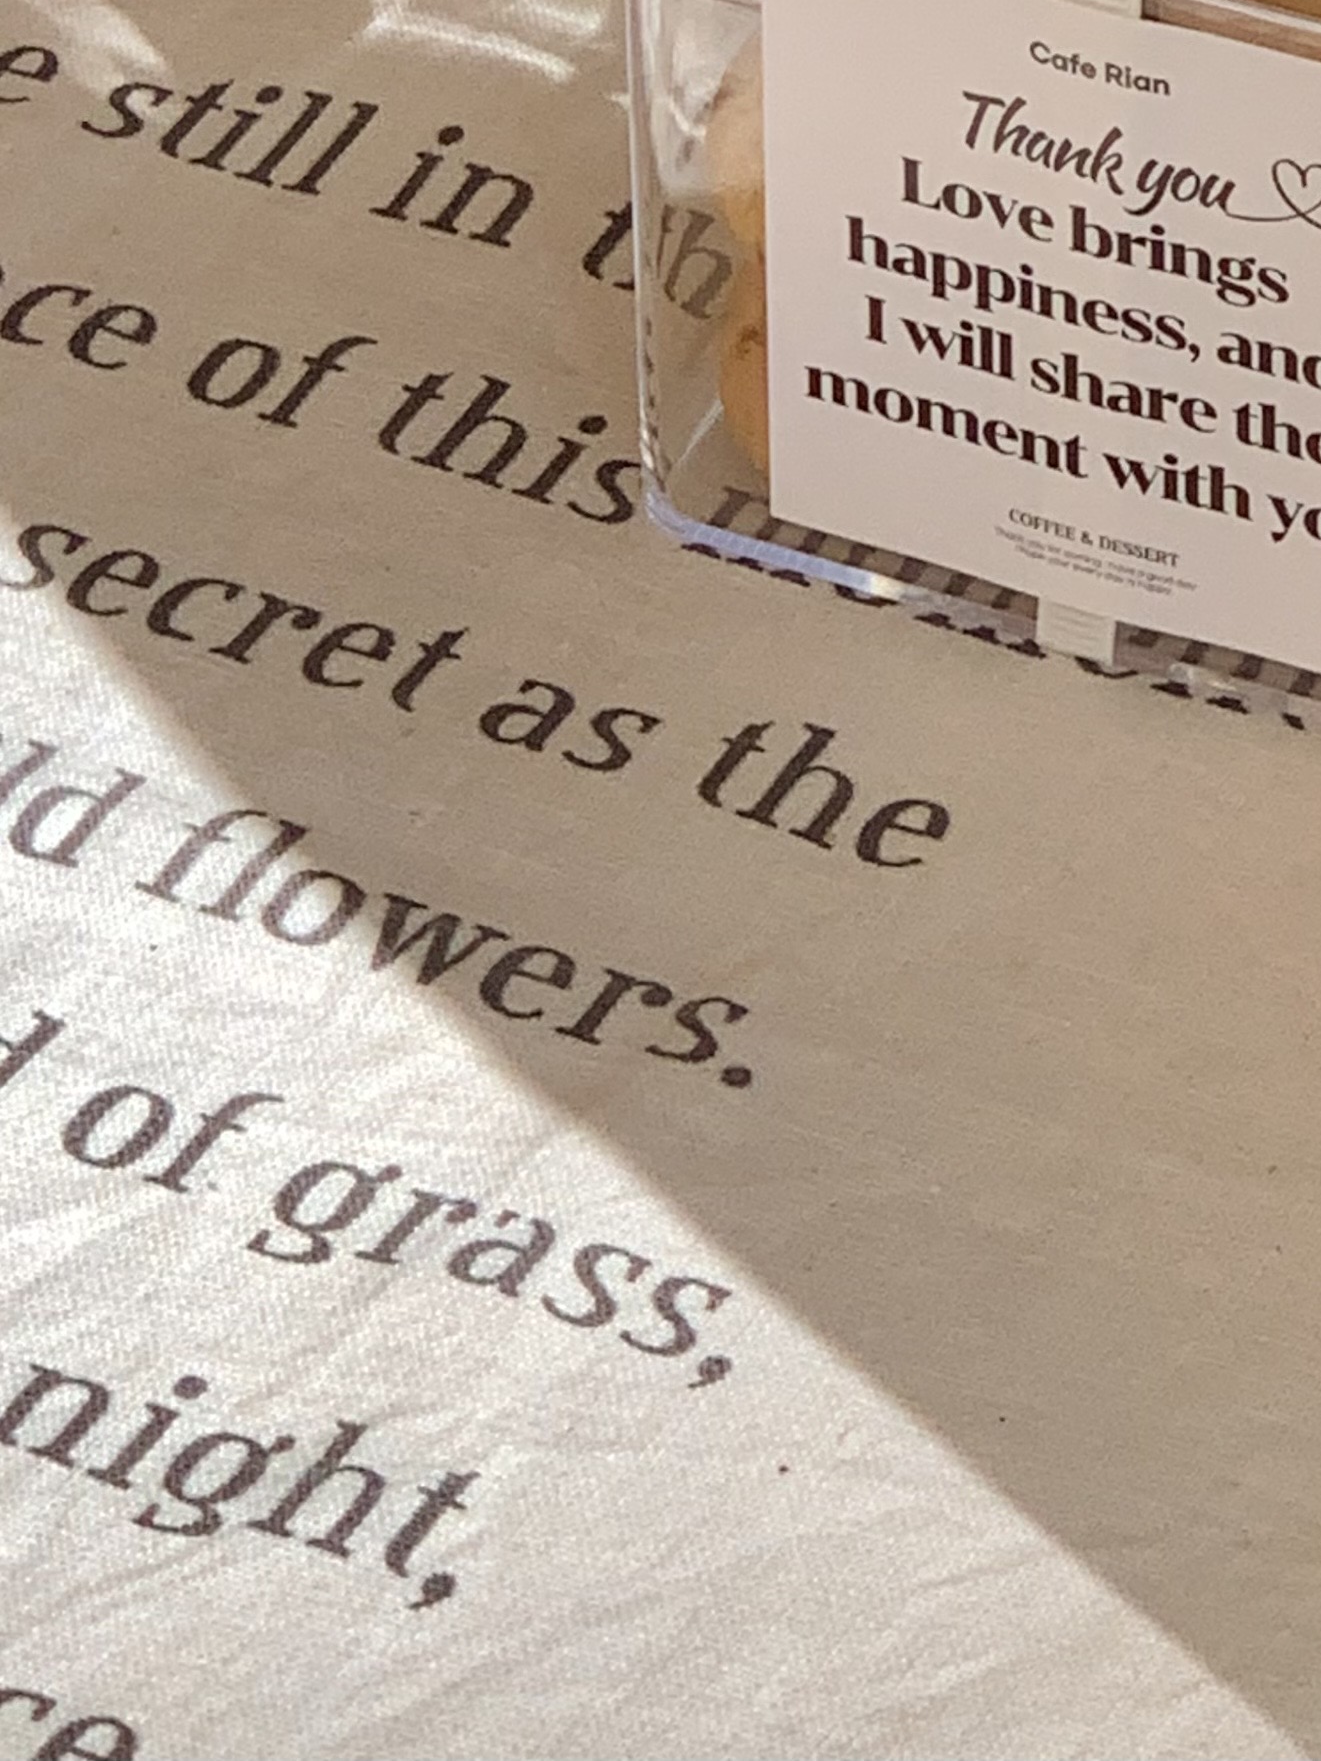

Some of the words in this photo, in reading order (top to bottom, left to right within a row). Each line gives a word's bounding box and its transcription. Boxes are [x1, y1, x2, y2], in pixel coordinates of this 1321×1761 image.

[1029, 41, 1097, 80] Cafe
[1104, 62, 1171, 96] Rian
[80, 78, 380, 197] still
[370, 125, 534, 249] in
[962, 90, 1125, 196] Thank
[1123, 158, 1239, 217] you
[846, 215, 1201, 363] happiness,
[902, 156, 1055, 243] Love
[1069, 204, 1290, 308] brings
[185, 335, 379, 429] of
[377, 371, 643, 526] this
[865, 295, 887, 345] I
[900, 318, 1015, 381] will
[1030, 353, 1218, 434] share
[805, 366, 1088, 479] moment
[1102, 452, 1252, 521] with
[1008, 508, 1076, 541] COFFEE
[1080, 530, 1094, 546] &
[1098, 535, 1179, 568] DESSERT
[0, 523, 470, 713] secret
[478, 678, 663, 774] as
[697, 720, 951, 869] the
[134, 808, 754, 1089] flowers.
[59, 1083, 285, 1192] of
[244, 1159, 734, 1392] grass,
[0, 1362, 482, 1613] night,
